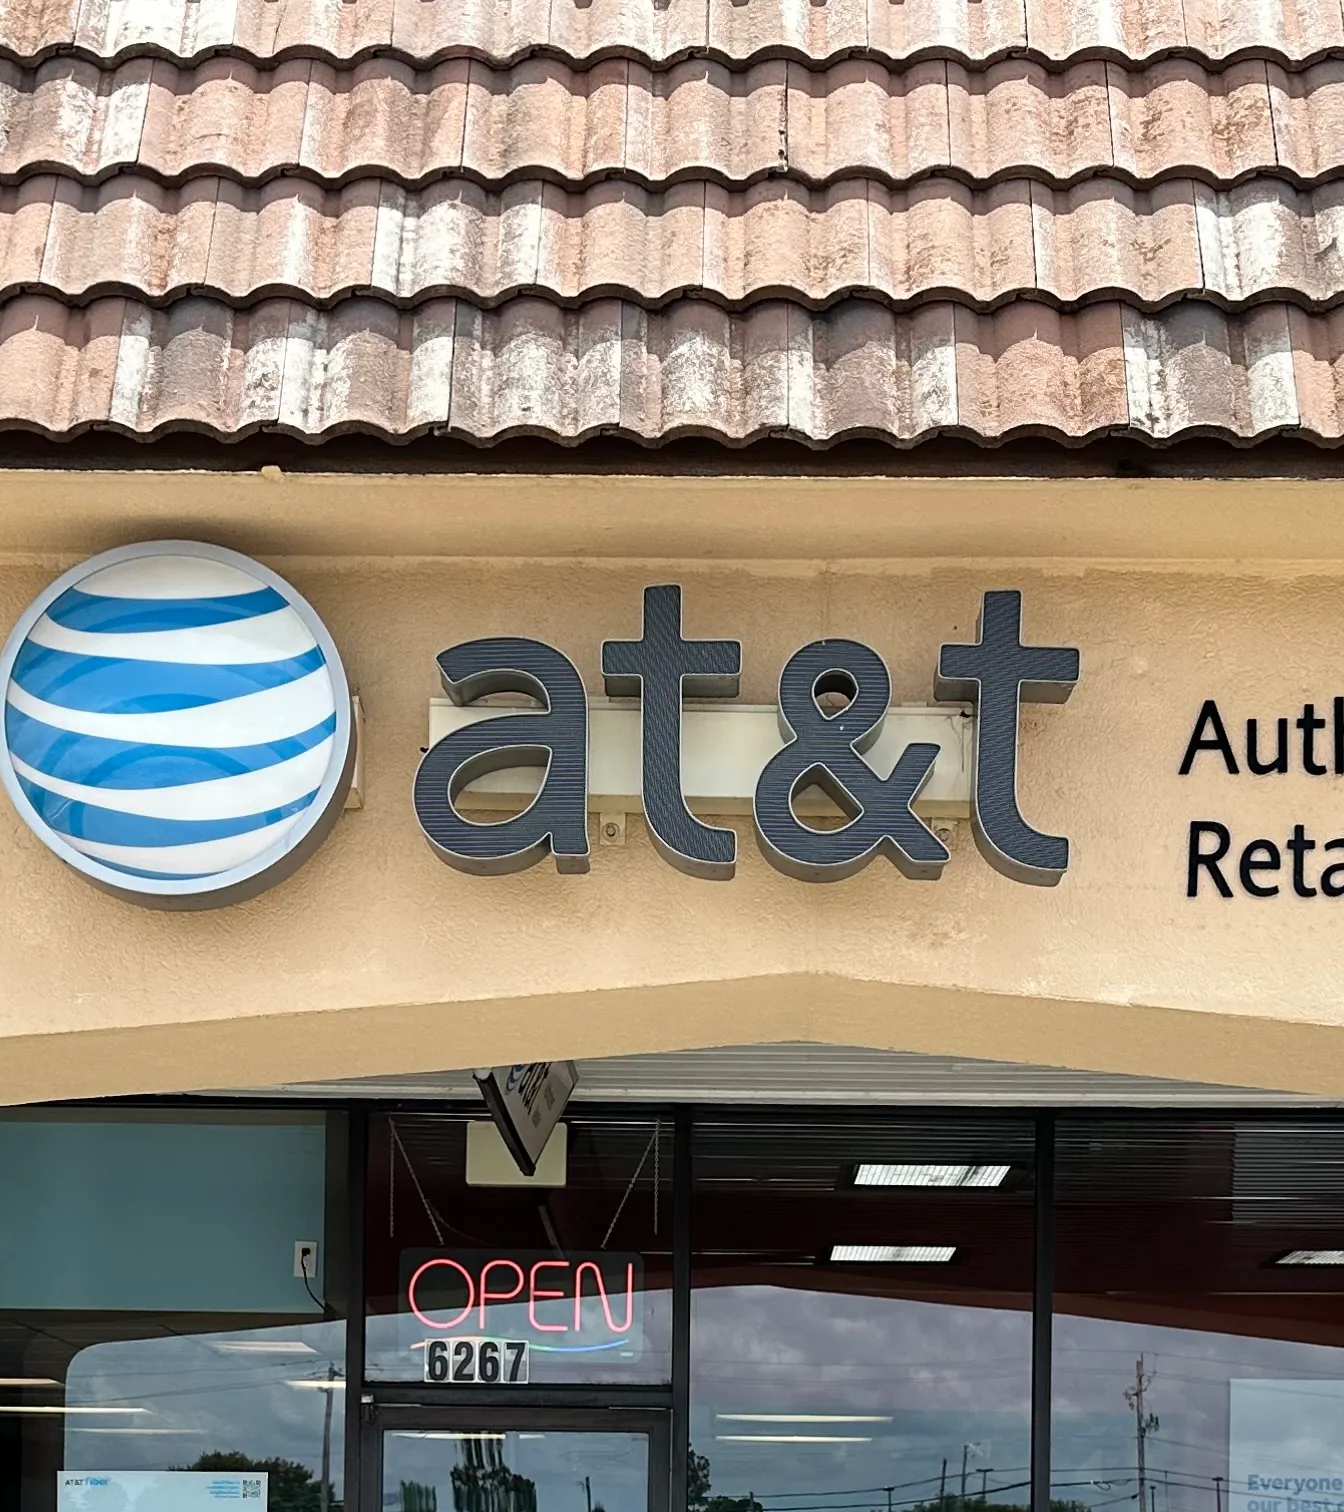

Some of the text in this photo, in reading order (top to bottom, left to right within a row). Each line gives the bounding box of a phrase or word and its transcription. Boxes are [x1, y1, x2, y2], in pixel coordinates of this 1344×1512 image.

[412, 583, 1081, 888] at&t
[408, 1258, 634, 1333] OPEN
[427, 1340, 527, 1383] 6267
[1246, 1474, 1344, 1496] Everyone
